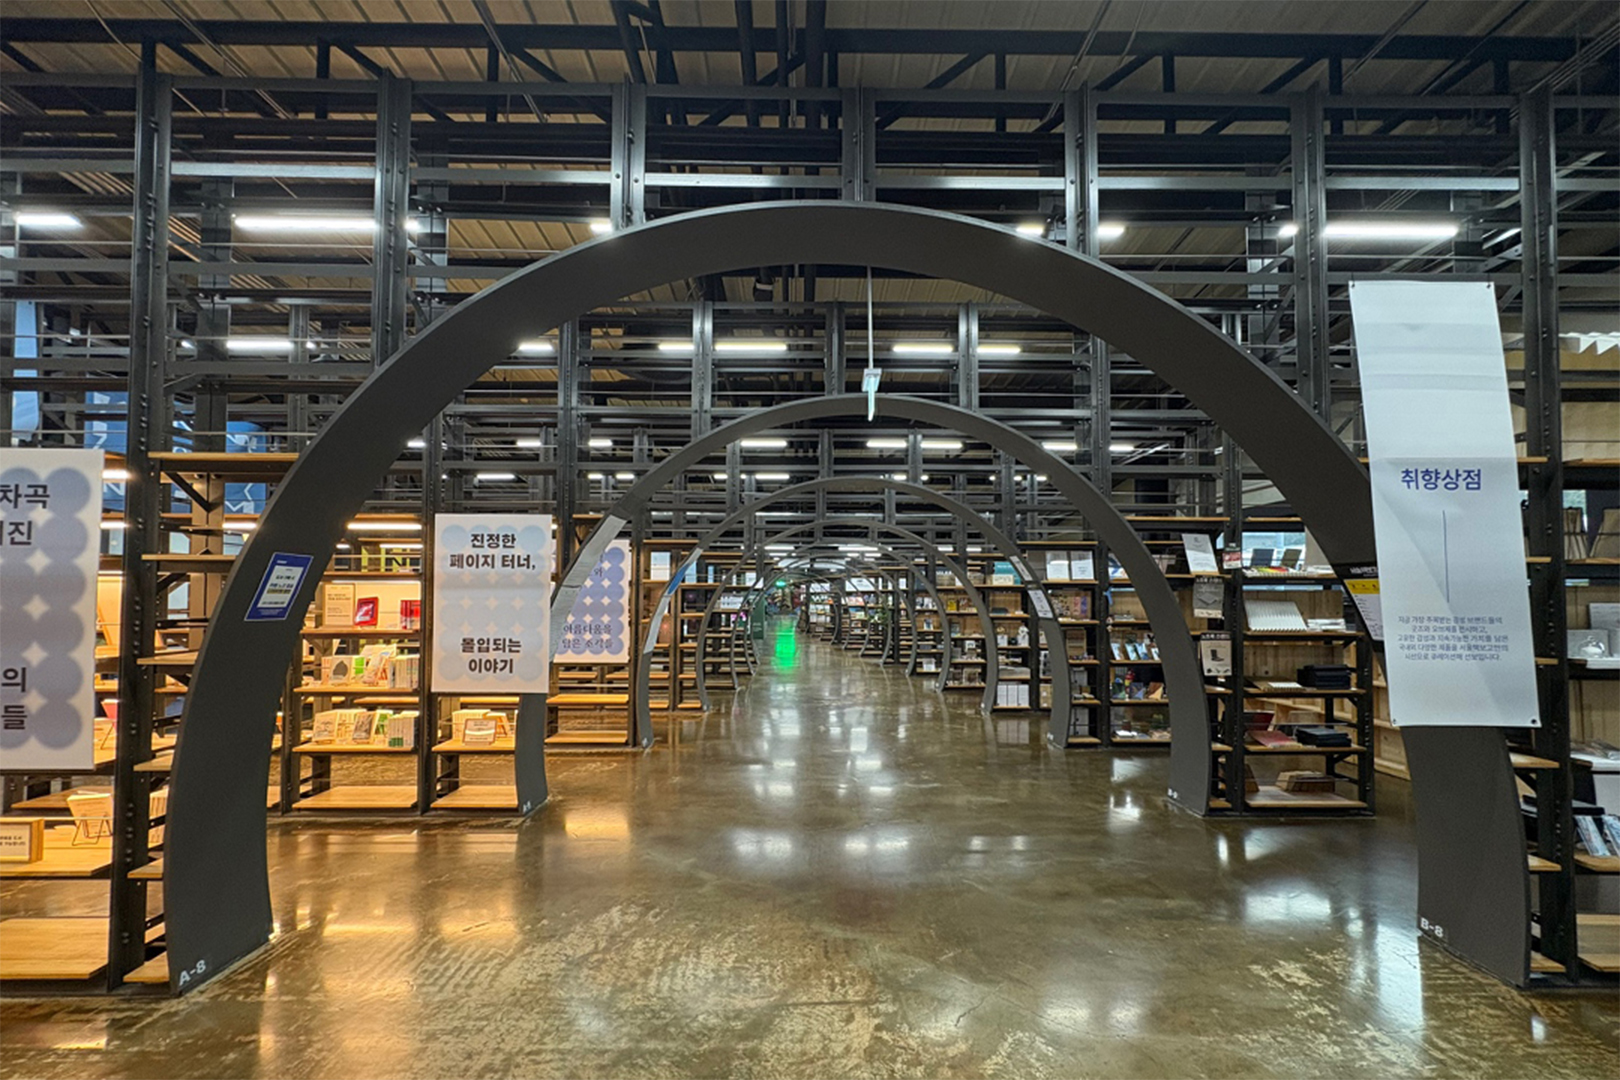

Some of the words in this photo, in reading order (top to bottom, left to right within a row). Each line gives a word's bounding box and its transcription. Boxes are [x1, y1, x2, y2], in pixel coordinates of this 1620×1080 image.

[1401, 468, 1481, 490] 취향상점
[471, 533, 516, 549] 진정한
[449, 554, 495, 569] 페이지
[501, 554, 536, 570] 터너,
[1412, 616, 1425, 624] 가장
[1427, 616, 1452, 624] 주목받는
[563, 624, 613, 635] 아름다움을
[461, 638, 522, 653] 몰입되는
[1418, 643, 1437, 652] 다양한
[468, 658, 513, 674] 이야기
[1420, 917, 1444, 938] B-8
[179, 959, 207, 987] A-8
